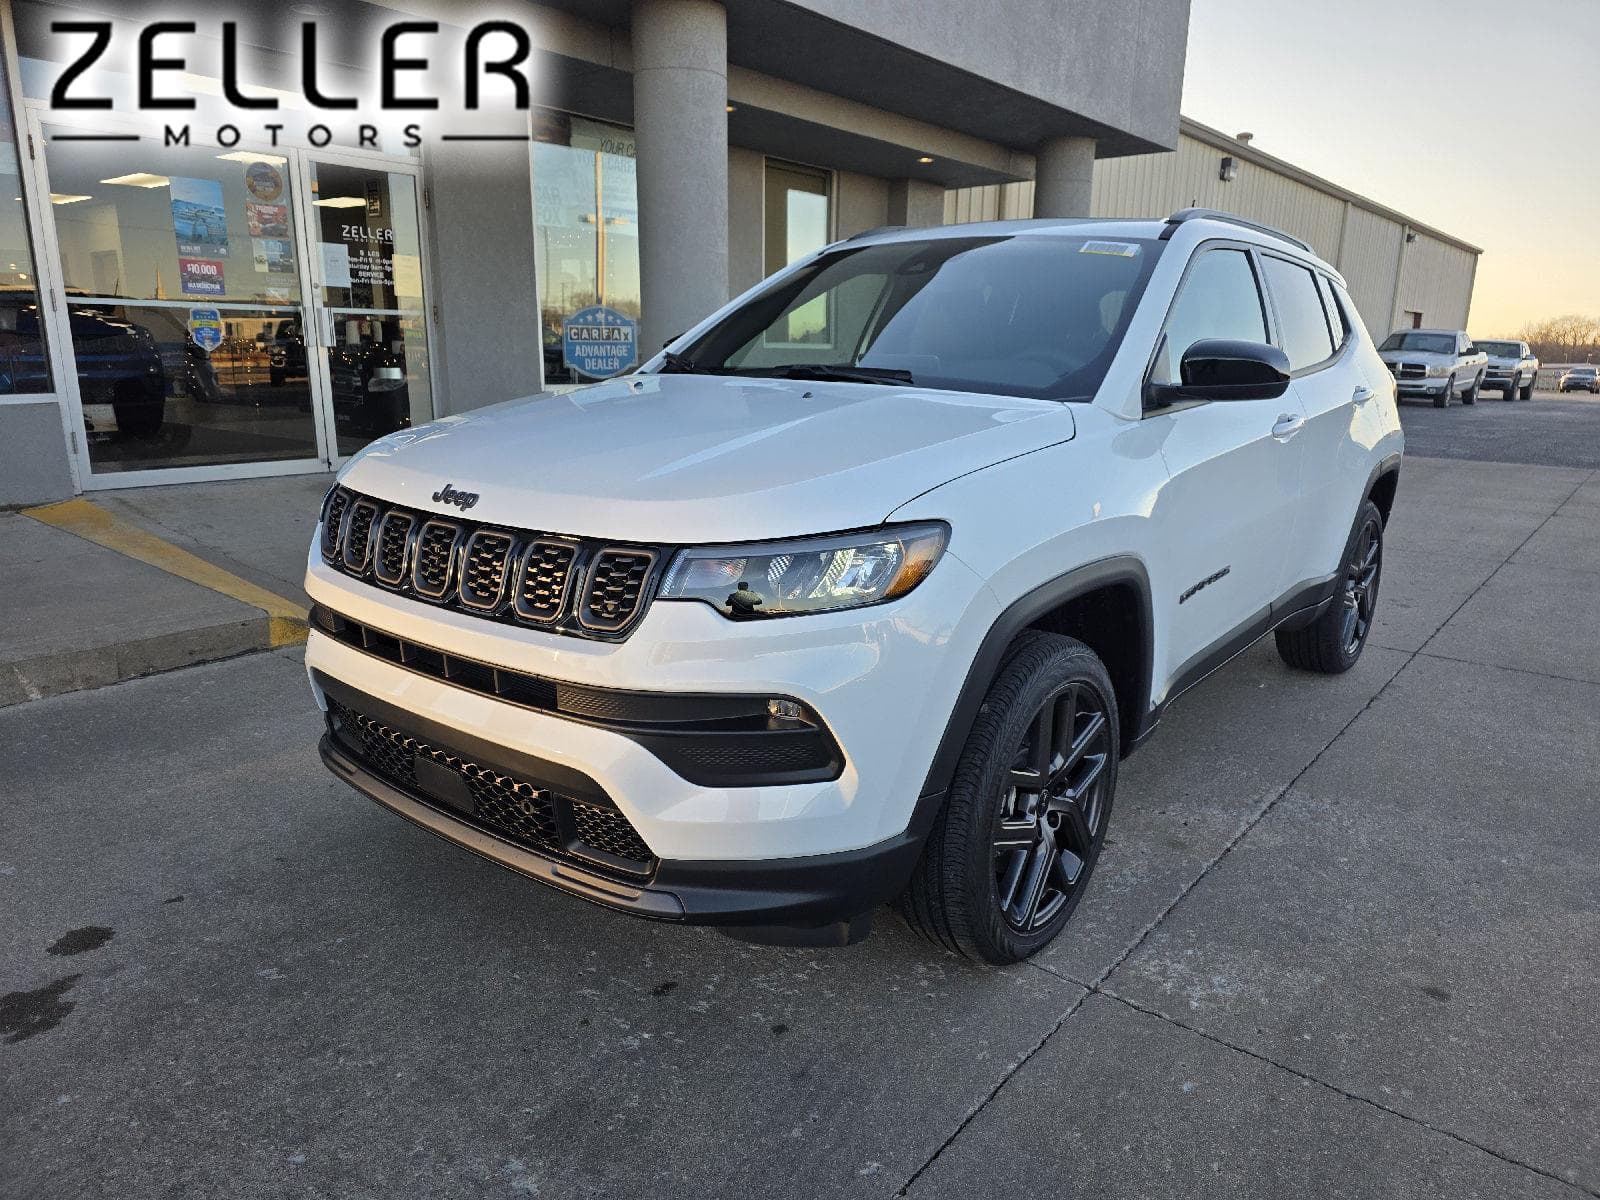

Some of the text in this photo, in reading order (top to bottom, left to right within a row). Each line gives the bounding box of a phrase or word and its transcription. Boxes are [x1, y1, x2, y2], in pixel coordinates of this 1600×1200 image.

[600, 138, 624, 156] YOUR
[341, 224, 393, 241] ZELLER
[569, 326, 631, 342] CARFAX
[575, 344, 628, 357] ADVANTAGE
[584, 357, 620, 370] DEALER
[432, 483, 479, 511] Jeep
